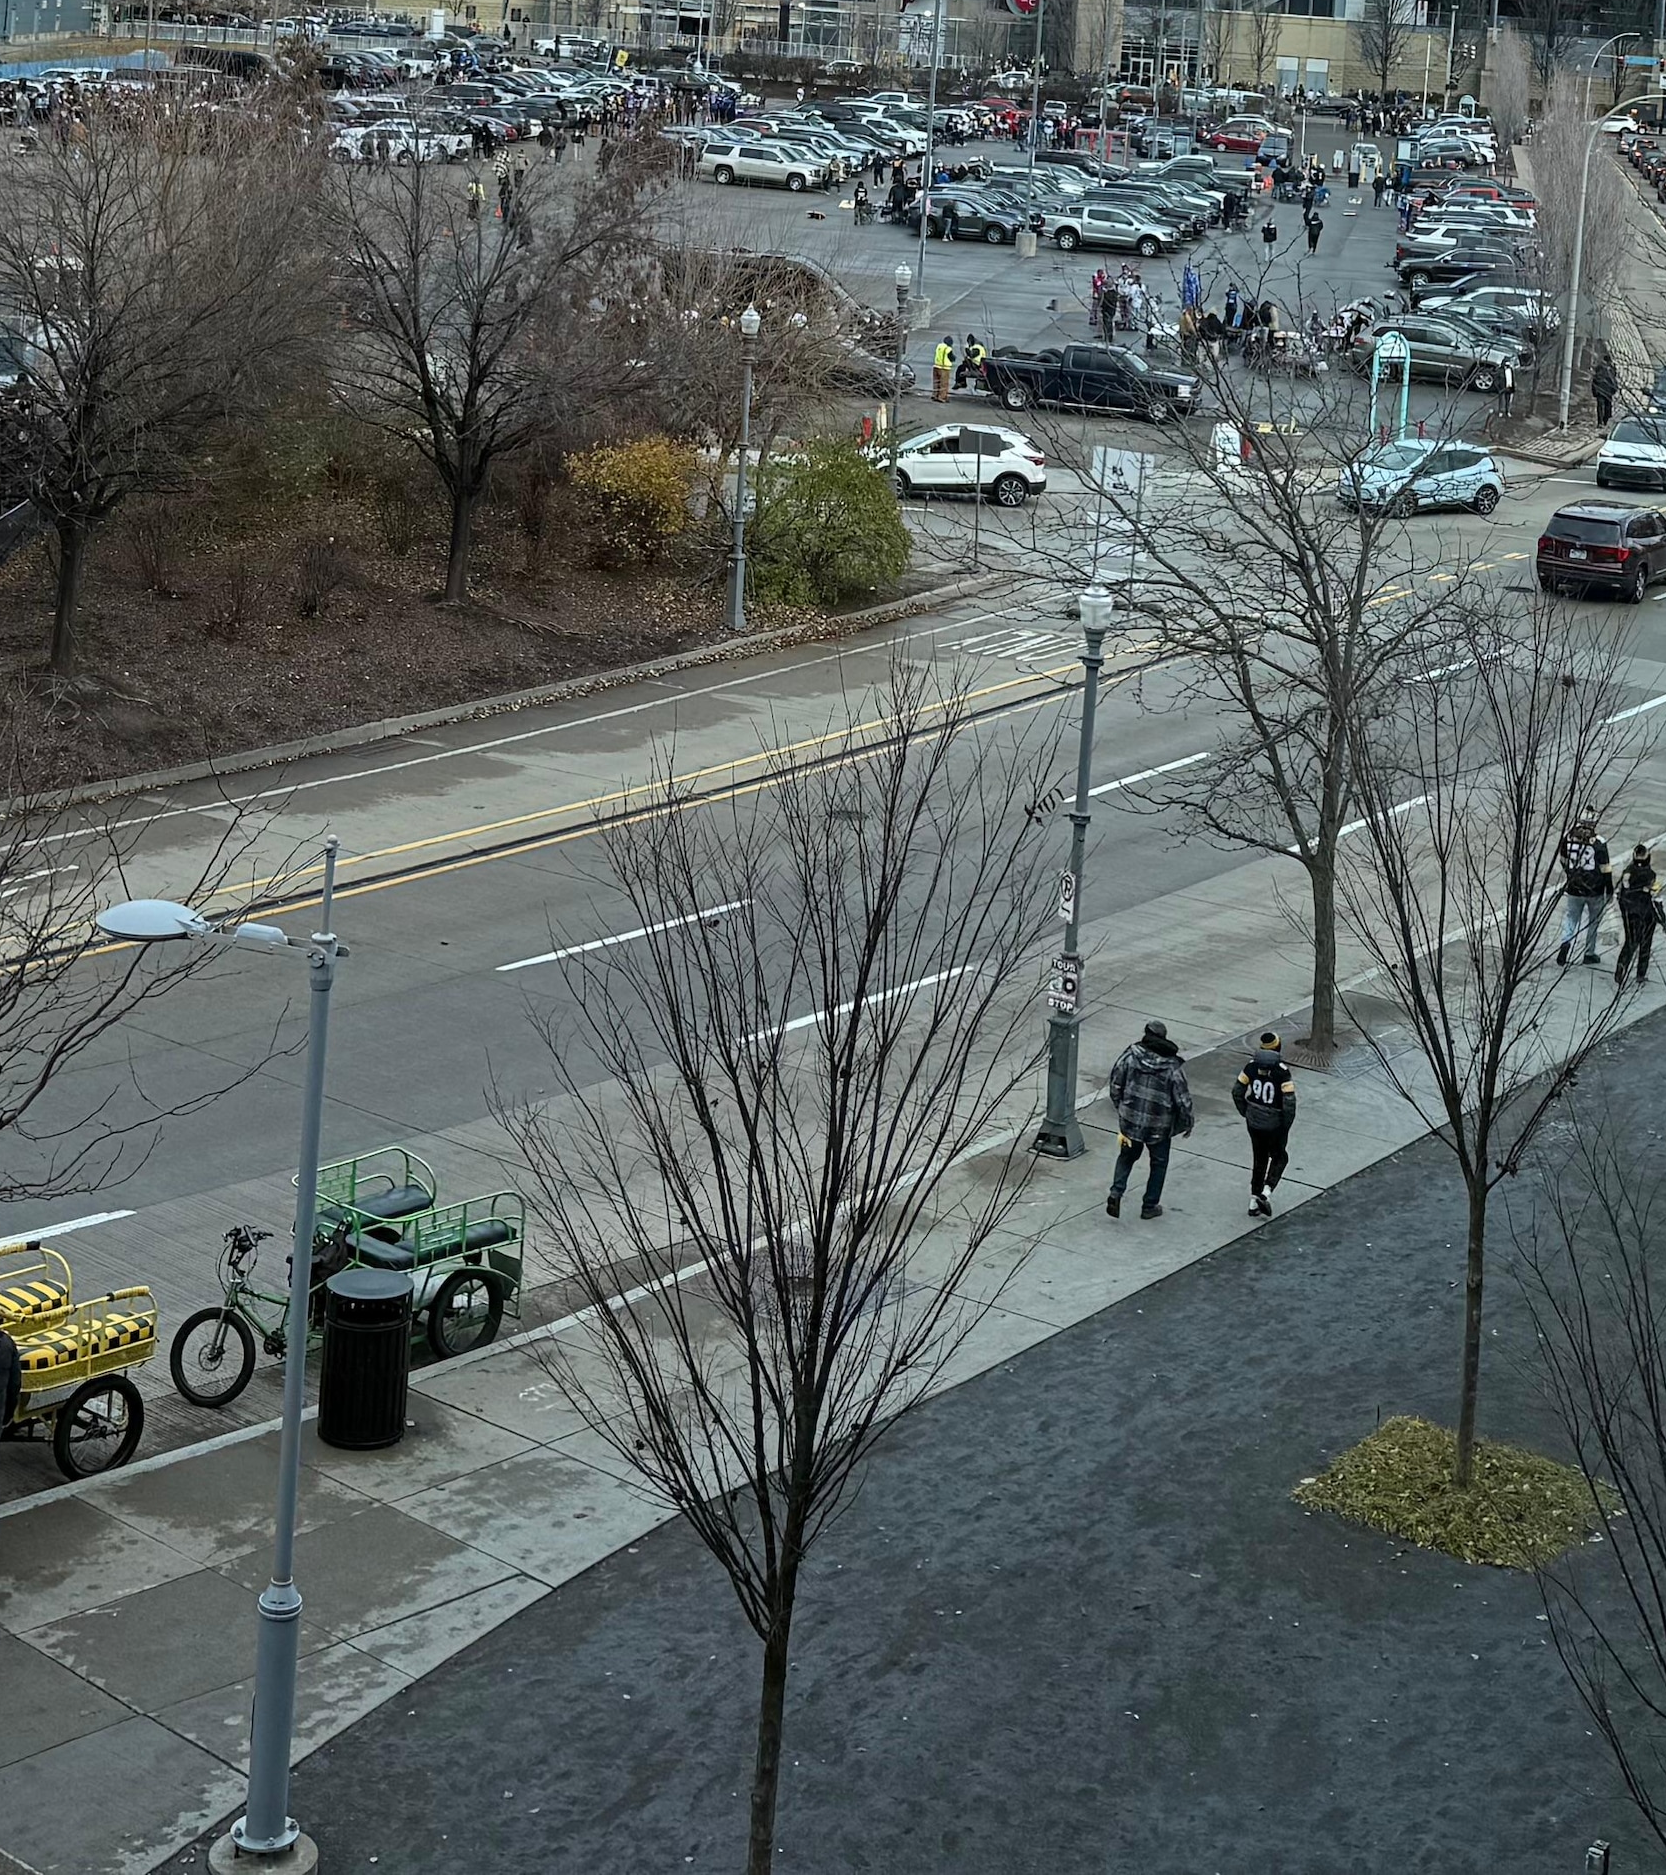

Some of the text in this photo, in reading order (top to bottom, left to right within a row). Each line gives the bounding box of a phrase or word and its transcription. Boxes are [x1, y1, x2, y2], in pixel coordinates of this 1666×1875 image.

[1052, 958, 1077, 973] TOUR
[1048, 997, 1074, 1013] STOP
[1253, 1079, 1275, 1104] 90
